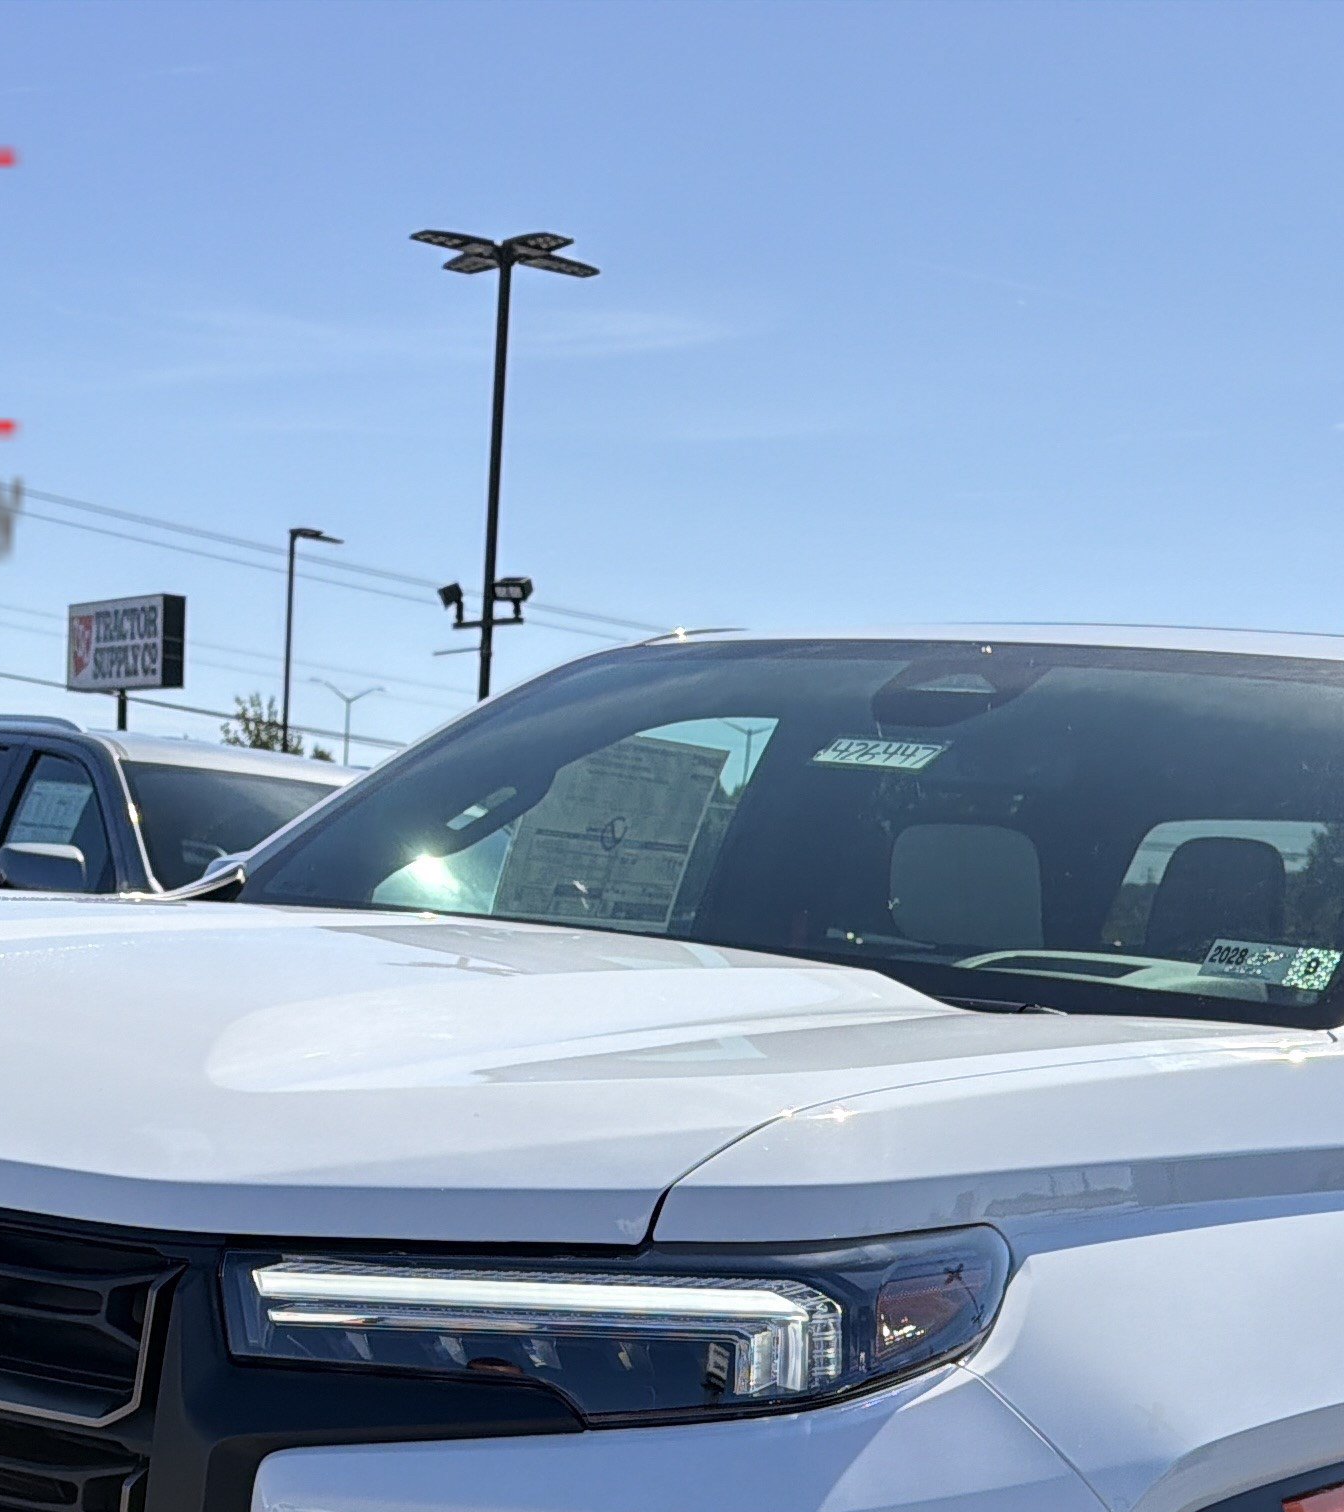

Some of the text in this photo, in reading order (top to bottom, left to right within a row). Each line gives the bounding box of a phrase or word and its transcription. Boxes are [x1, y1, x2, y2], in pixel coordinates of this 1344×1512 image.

[95, 605, 158, 643] TRACTOR
[93, 645, 139, 680] SUPPLY
[1209, 945, 1249, 965] 2028
